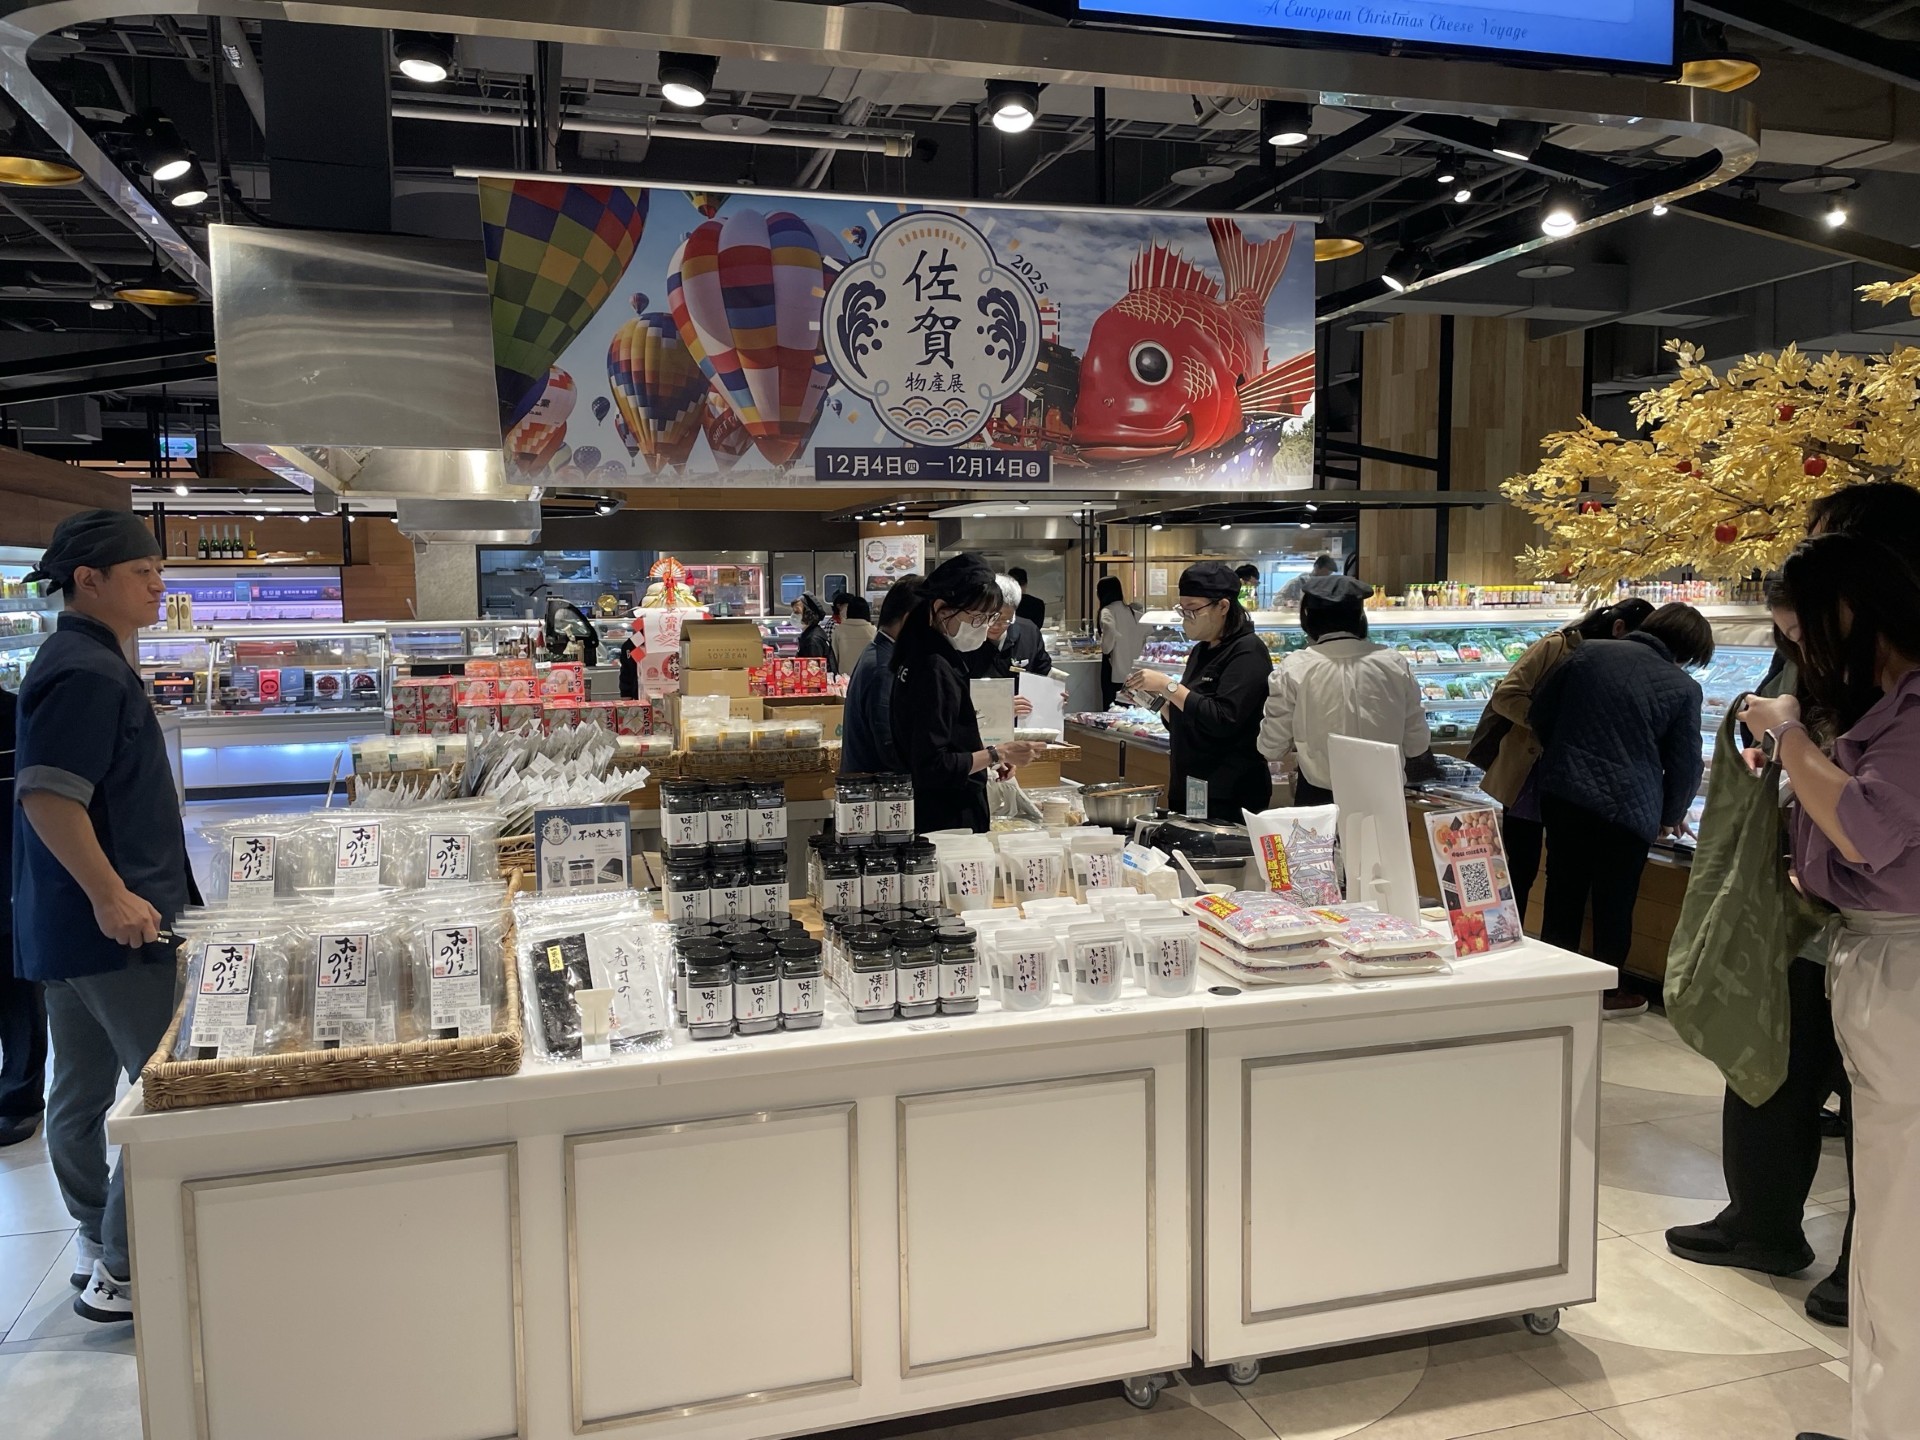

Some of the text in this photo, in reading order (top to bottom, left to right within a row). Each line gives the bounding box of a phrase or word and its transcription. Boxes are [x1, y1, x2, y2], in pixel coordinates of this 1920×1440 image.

[1285, 0, 1351, 22] European
[1357, 6, 1424, 27] Christmas
[1429, 13, 1474, 32] Cheese
[1481, 18, 1528, 40] Voyage
[1011, 254, 1049, 294] 2025
[902, 247, 962, 369] 佐賀
[905, 372, 966, 394] 物產展
[680, 816, 693, 842] 味のり
[721, 813, 733, 839] 味のり
[762, 811, 774, 837] 味のり
[852, 805, 865, 830] 焼のり
[890, 802, 902, 828] 焼のり
[239, 852, 252, 879] のり
[346, 840, 358, 866] のり
[436, 850, 448, 876] のり
[959, 863, 971, 896] ふりかけ
[1027, 859, 1038, 893] ふりかけ
[1090, 854, 1101, 887] ふりかけ
[682, 893, 694, 918] 味のり
[725, 890, 737, 916] 味のり
[765, 887, 777, 913] 味のり
[334, 937, 357, 979] おにぎり
[440, 946, 453, 974] のり
[446, 930, 468, 970] おにぎり
[1161, 941, 1174, 978] ふりかけ
[211, 962, 226, 991] のり
[327, 953, 341, 983] のり
[608, 946, 631, 1011] 寿司のり
[954, 966, 967, 994] 焼のり
[1017, 954, 1030, 992] ふりかけ
[1089, 948, 1101, 986] ふりかけ
[798, 981, 812, 1009] 味のり
[869, 974, 882, 1003] 焼のり
[913, 970, 927, 998] 焼のり
[701, 990, 717, 1019] 味のり
[751, 985, 766, 1014] 味のり
